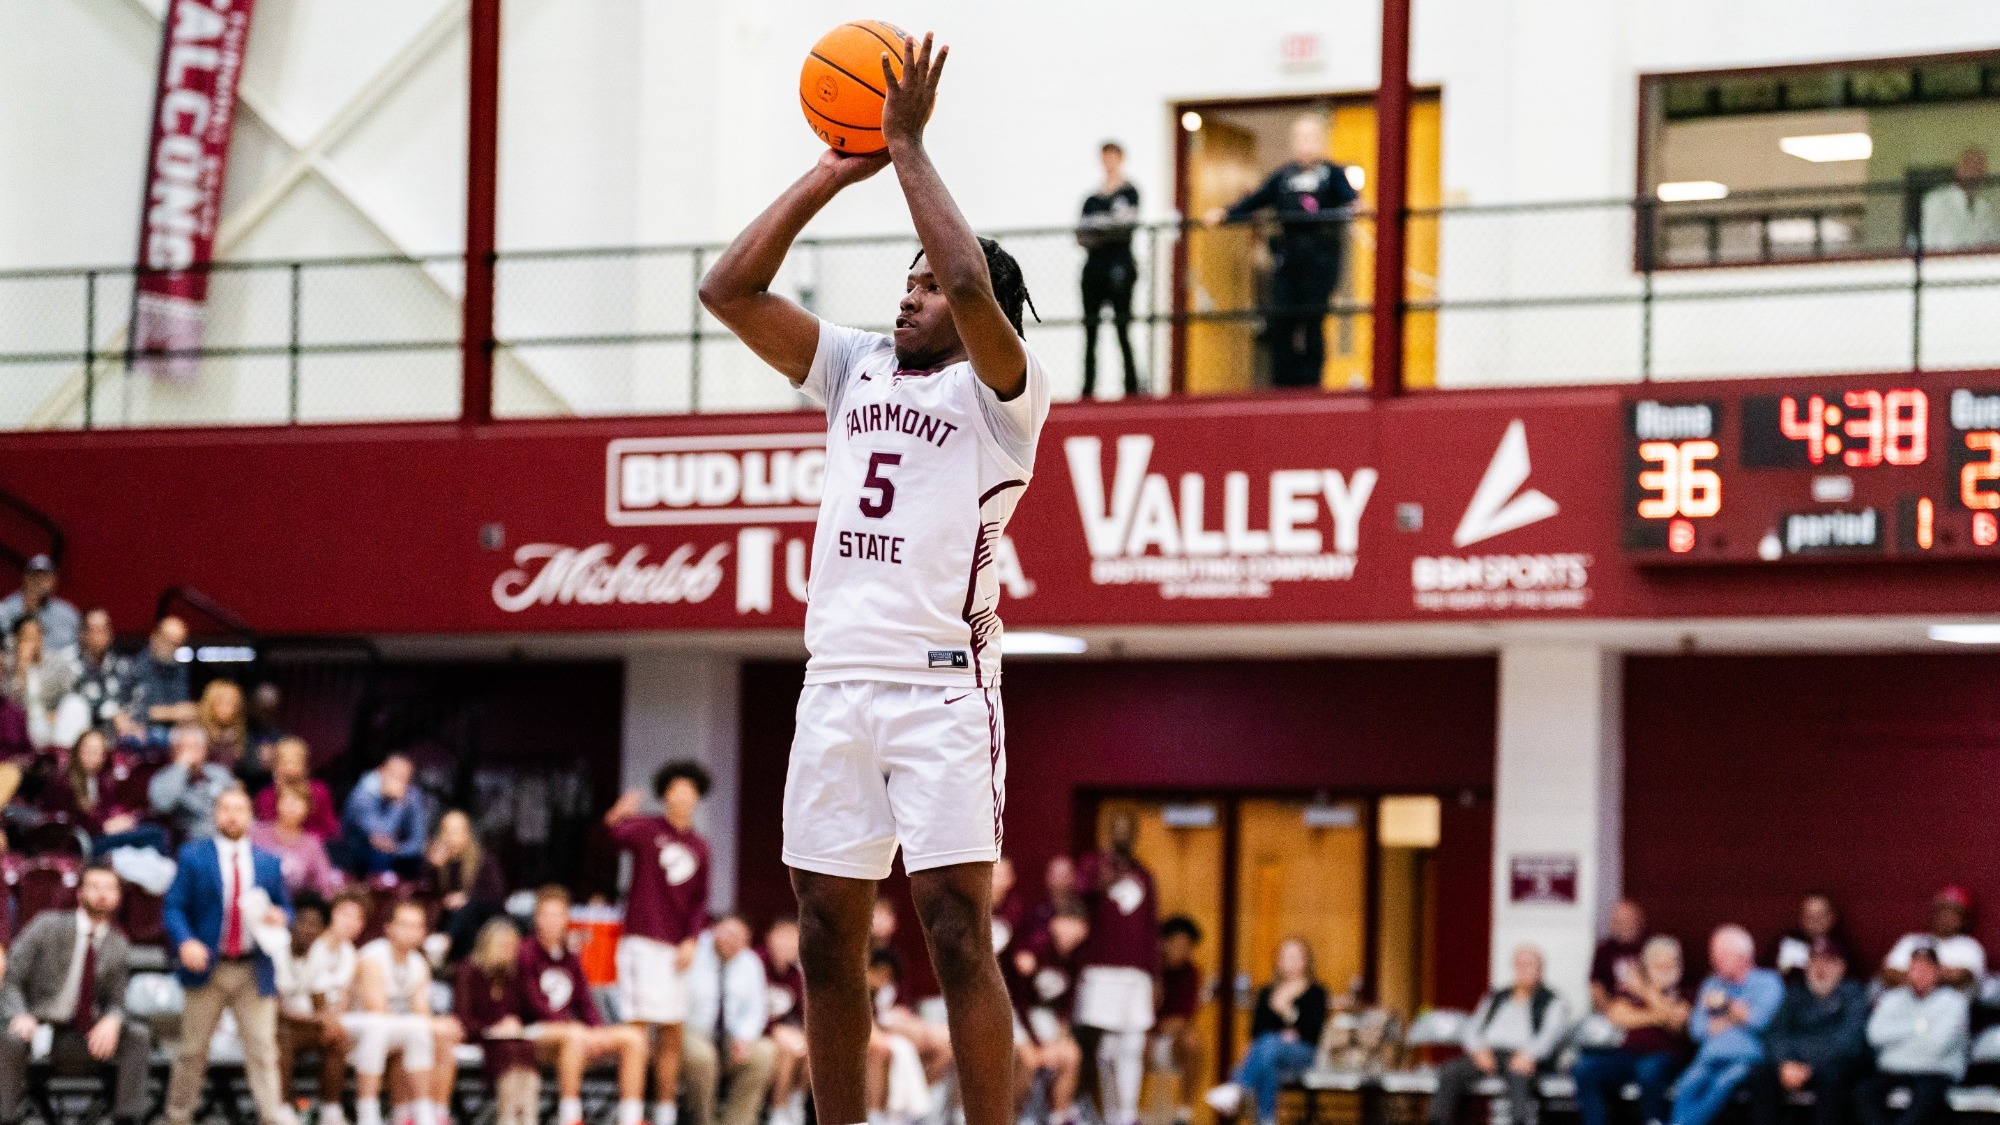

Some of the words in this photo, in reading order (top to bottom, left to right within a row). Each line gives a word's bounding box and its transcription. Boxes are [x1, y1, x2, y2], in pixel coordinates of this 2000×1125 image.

[149, 0, 229, 271] ALCONS
[846, 403, 958, 448] FAIRMONT
[1780, 388, 1929, 467] 4:38
[621, 453, 740, 508] BUD
[741, 450, 827, 506] LIG
[858, 451, 903, 520] 5
[1064, 435, 1378, 556] VALLEY
[1638, 440, 1722, 518] 36
[1960, 431, 2000, 510] 2
[839, 530, 905, 565] STATE
[1917, 497, 1933, 549] 1
